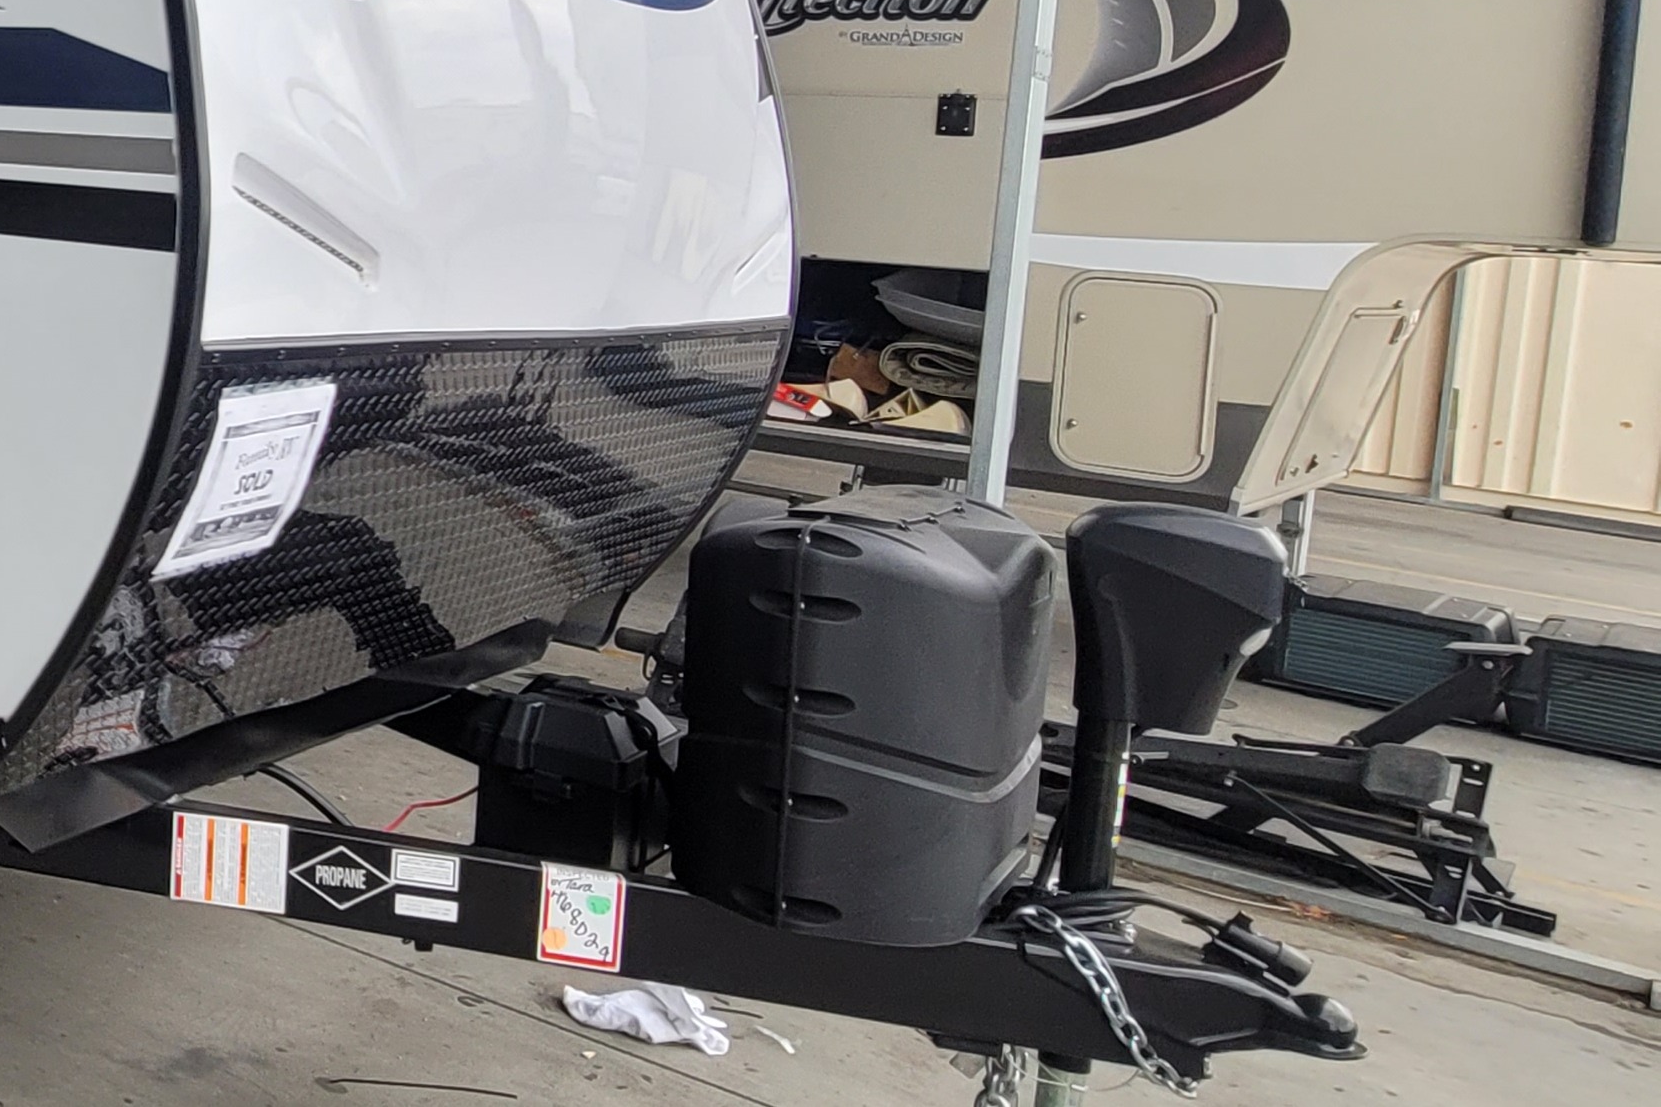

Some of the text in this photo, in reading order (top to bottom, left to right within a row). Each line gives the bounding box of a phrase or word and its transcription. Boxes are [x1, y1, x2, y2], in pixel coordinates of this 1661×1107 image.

[850, 29, 900, 43] GRAND
[913, 29, 964, 43] DESIGN
[234, 468, 275, 495] SOLD
[315, 864, 367, 890] PROPANE
